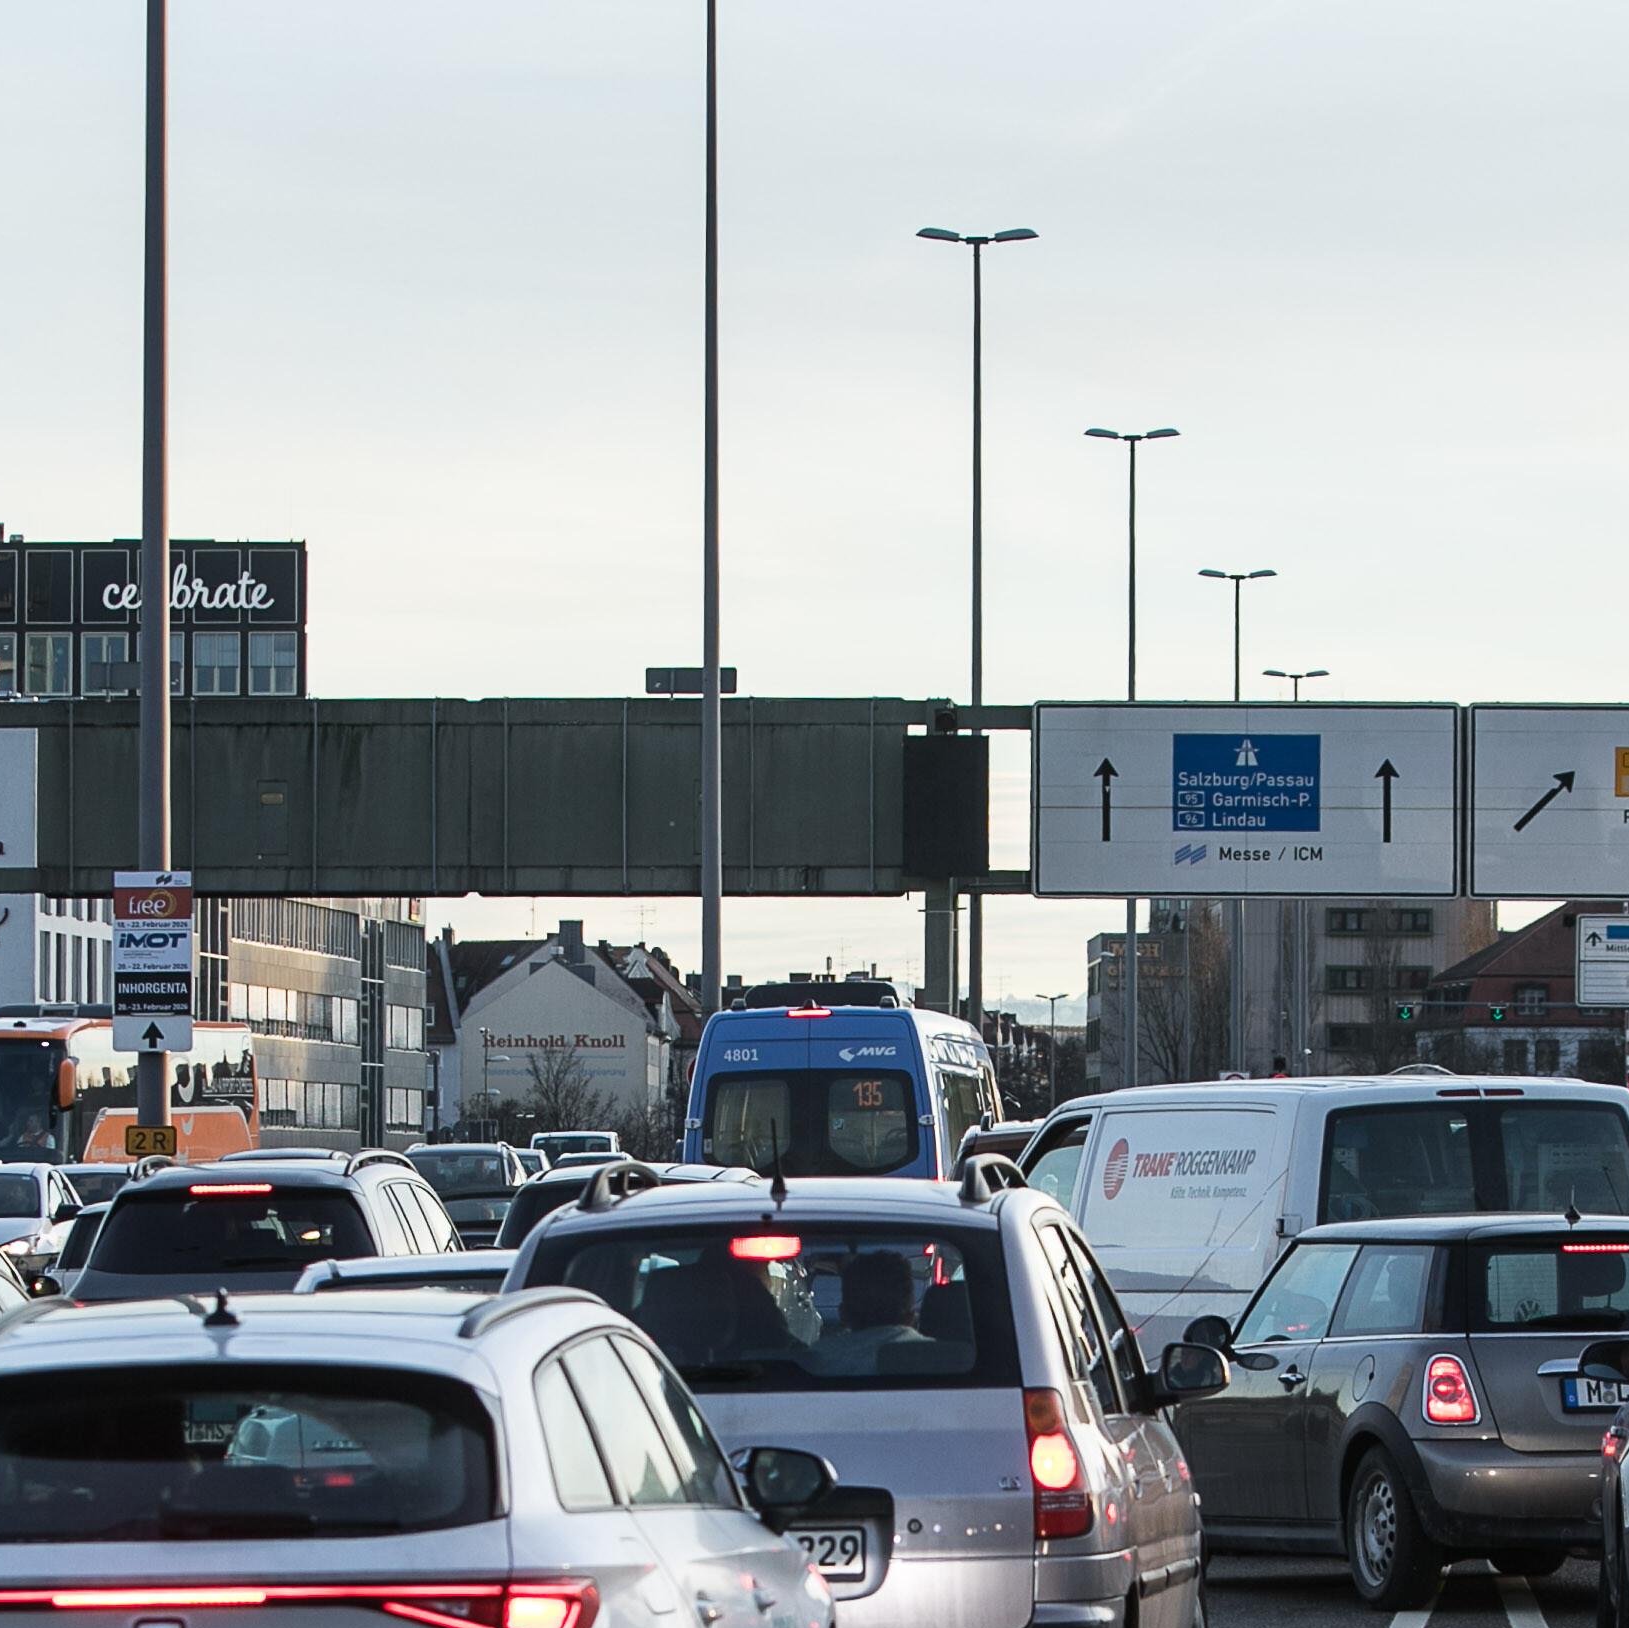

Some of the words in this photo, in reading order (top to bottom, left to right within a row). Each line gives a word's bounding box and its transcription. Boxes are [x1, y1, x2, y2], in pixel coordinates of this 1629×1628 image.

[102, 563, 274, 609] cebrate
[1178, 772, 1315, 790] Salzburg/Passau
[1185, 794, 1198, 804] 95
[1212, 793, 1312, 807] Garmisch-P.
[1185, 814, 1198, 824] 96
[1212, 812, 1266, 827] Lindau
[1219, 847, 1271, 861] Messe
[1294, 847, 1323, 861] ICM
[118, 933, 188, 948] iMOT
[118, 983, 188, 994] INHORGENTA
[483, 1034, 565, 1048] Reinhold
[574, 1034, 626, 1048] Knoll
[724, 1048, 759, 1062] 4801
[857, 1046, 897, 1057] MVG
[852, 1081, 883, 1107] 135
[135, 1132, 147, 1150] 2
[153, 1132, 166, 1151] R
[1133, 1152, 1174, 1178] TRANE
[1174, 1149, 1257, 1177] ROGGENKAMP
[1587, 1381, 1602, 1404] M
